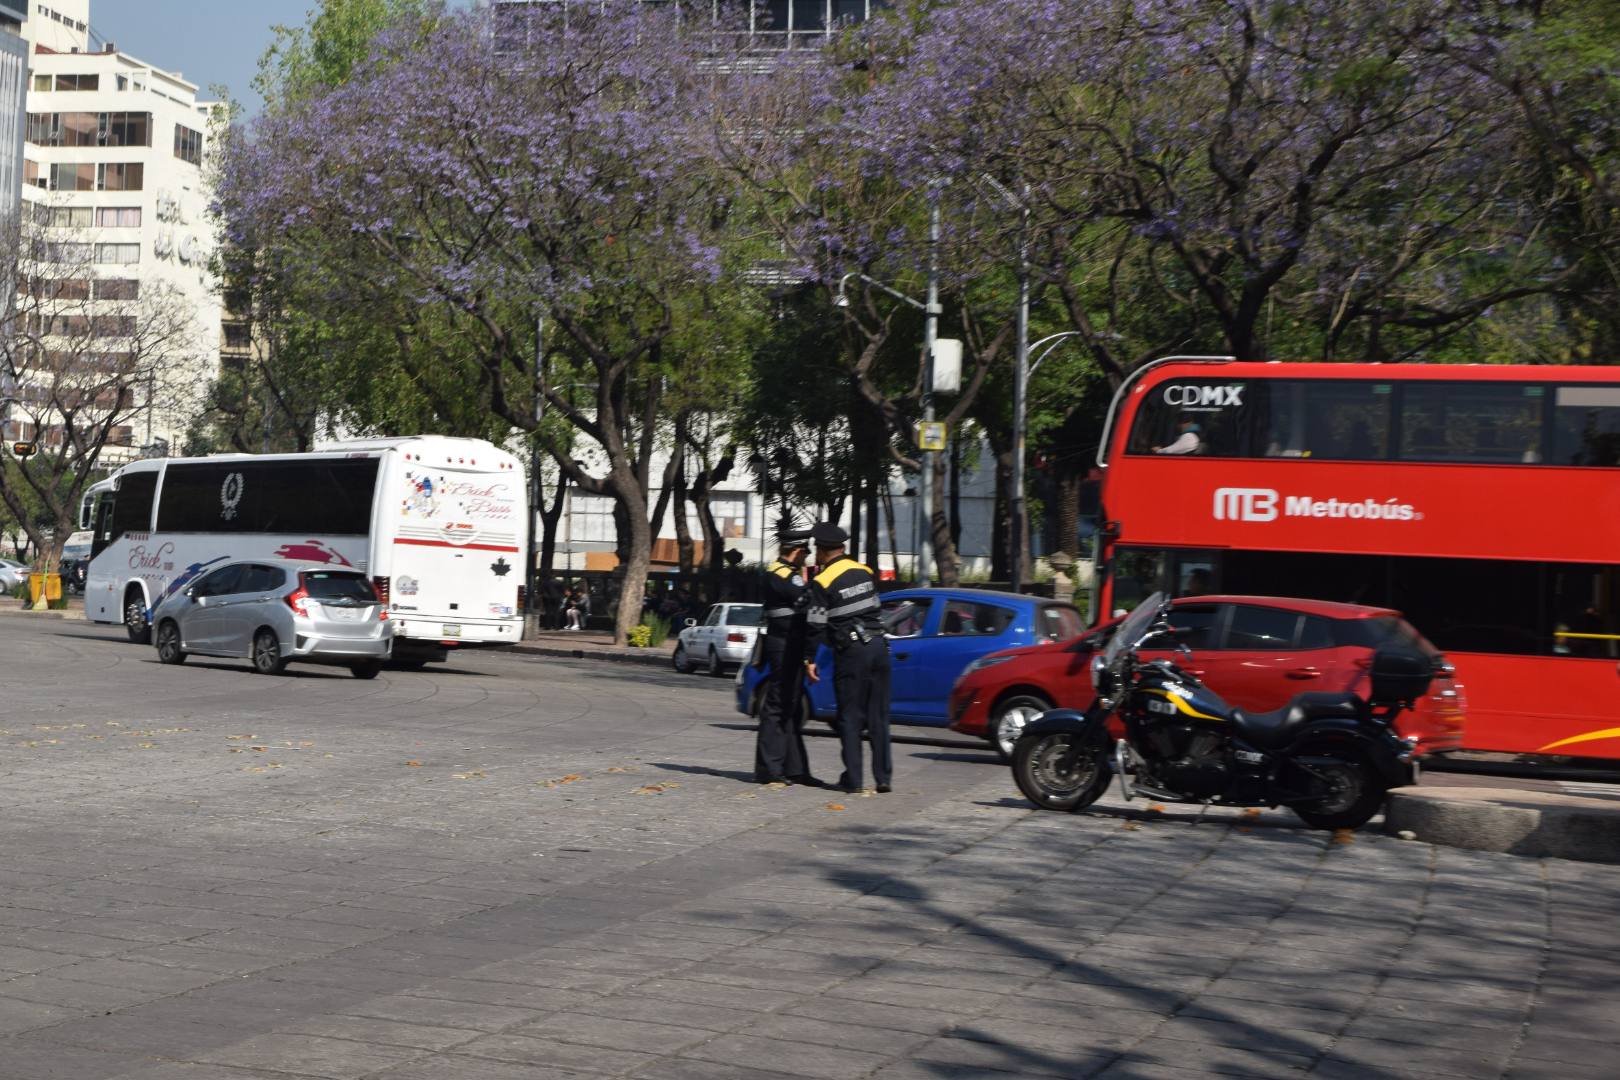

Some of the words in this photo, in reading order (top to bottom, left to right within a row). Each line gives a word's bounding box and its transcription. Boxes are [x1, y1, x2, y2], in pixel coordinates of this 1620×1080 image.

[1163, 385, 1244, 406] CDMX
[1285, 496, 1415, 521] Metrobús
[128, 541, 175, 570] Erick
